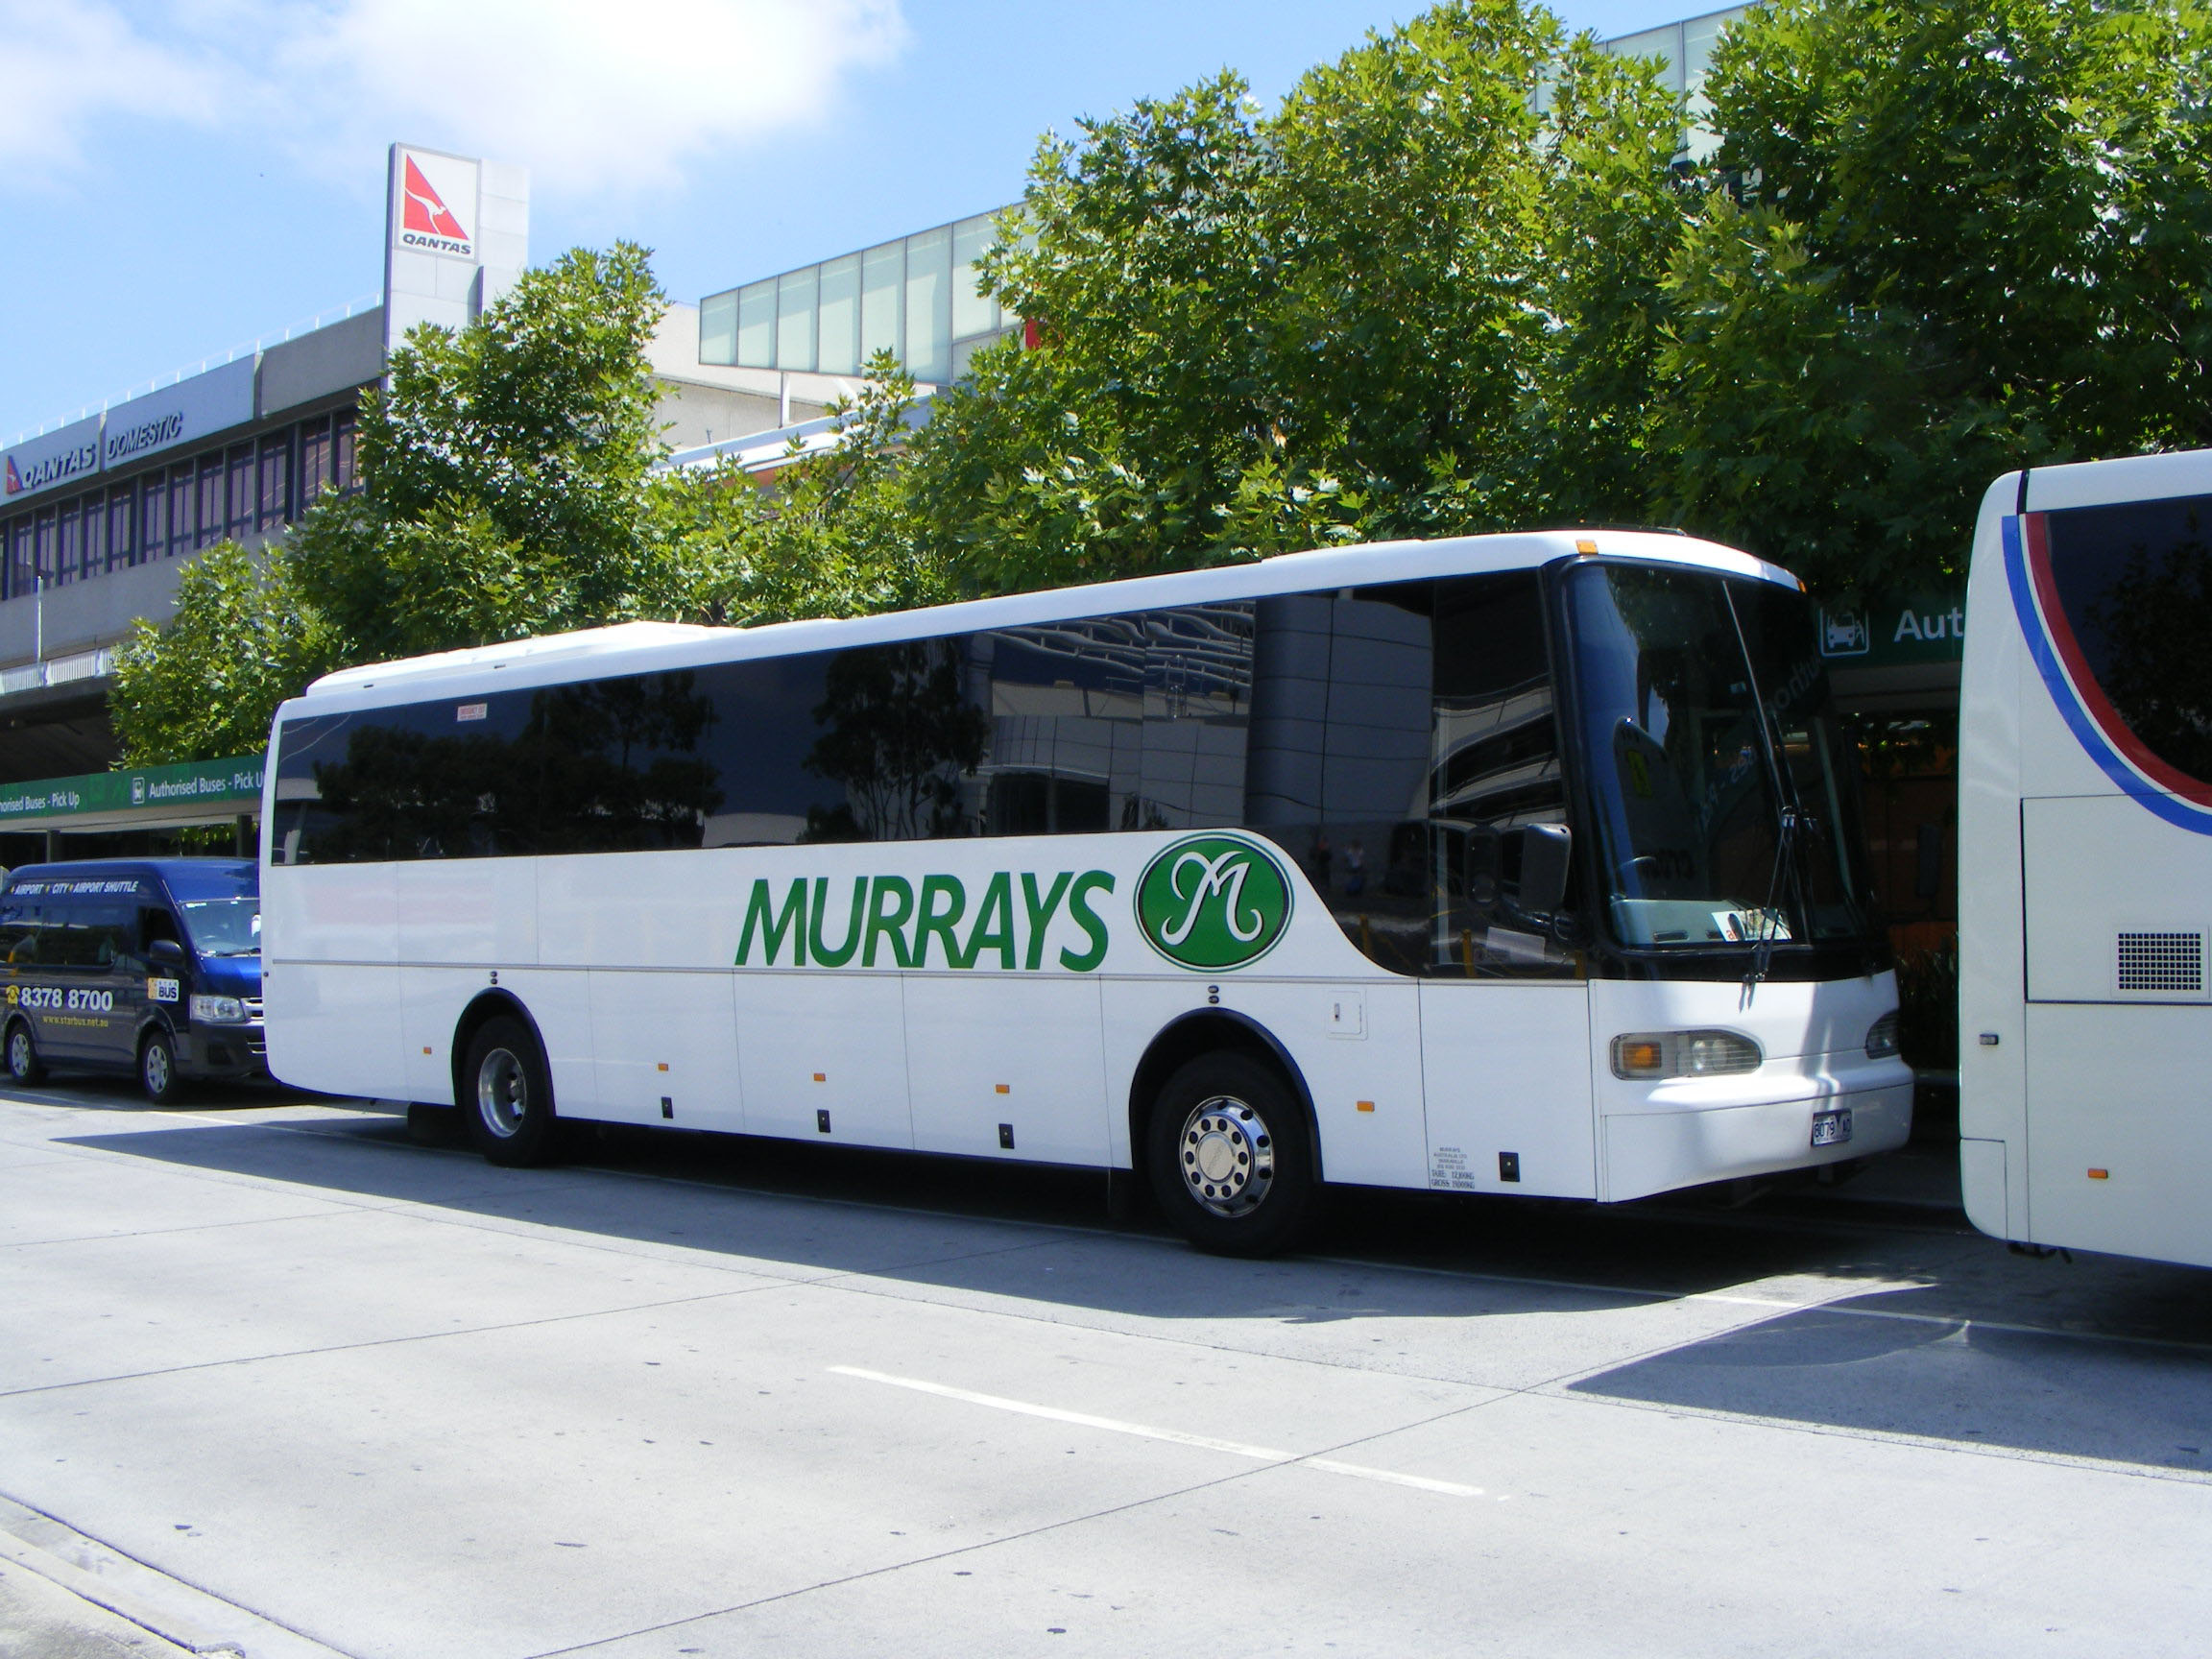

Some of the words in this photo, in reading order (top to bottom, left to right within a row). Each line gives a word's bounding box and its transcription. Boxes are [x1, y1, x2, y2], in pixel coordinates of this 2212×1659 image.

[402, 233, 471, 255] QANTAS
[22, 445, 96, 490] QANTAS
[107, 411, 183, 460] DOMESTIC
[1893, 607, 1963, 642] Aut
[149, 779, 198, 799] Authorised
[200, 777, 226, 794] Buses
[234, 772, 254, 790] Pick
[255, 771, 264, 788] U
[25, 796, 46, 811] Buses
[52, 793, 68, 808] Pick
[68, 793, 80, 809] Up
[14, 883, 44, 895] AIRPORT
[52, 883, 69, 895] CITY
[73, 881, 105, 894] AIRPORT
[104, 880, 139, 893] SHUTTLE
[734, 870, 1116, 973] MURRAYS
[21, 987, 63, 1008] 8378
[67, 990, 113, 1011] 8700
[158, 986, 178, 999] BUS
[42, 1016, 108, 1028] www.starbus.net.au
